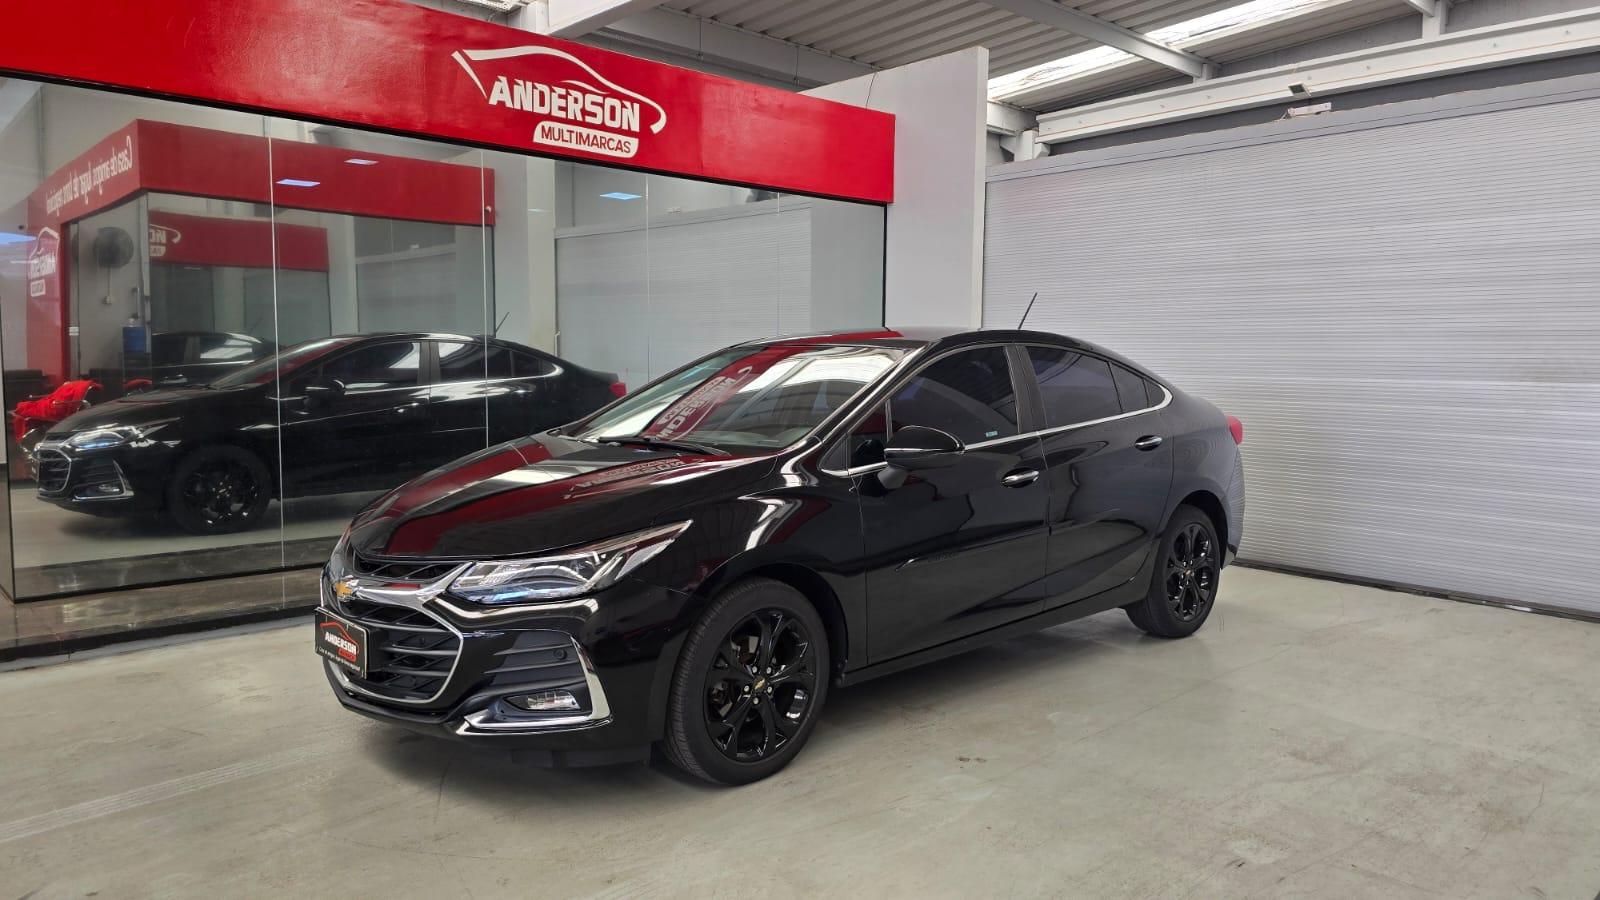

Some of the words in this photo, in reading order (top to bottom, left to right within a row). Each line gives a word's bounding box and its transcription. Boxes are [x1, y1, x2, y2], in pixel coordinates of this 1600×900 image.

[488, 75, 640, 132] ANDERSON
[541, 125, 631, 154] MULTIMARCAS
[325, 632, 356, 655] ANDERSON
